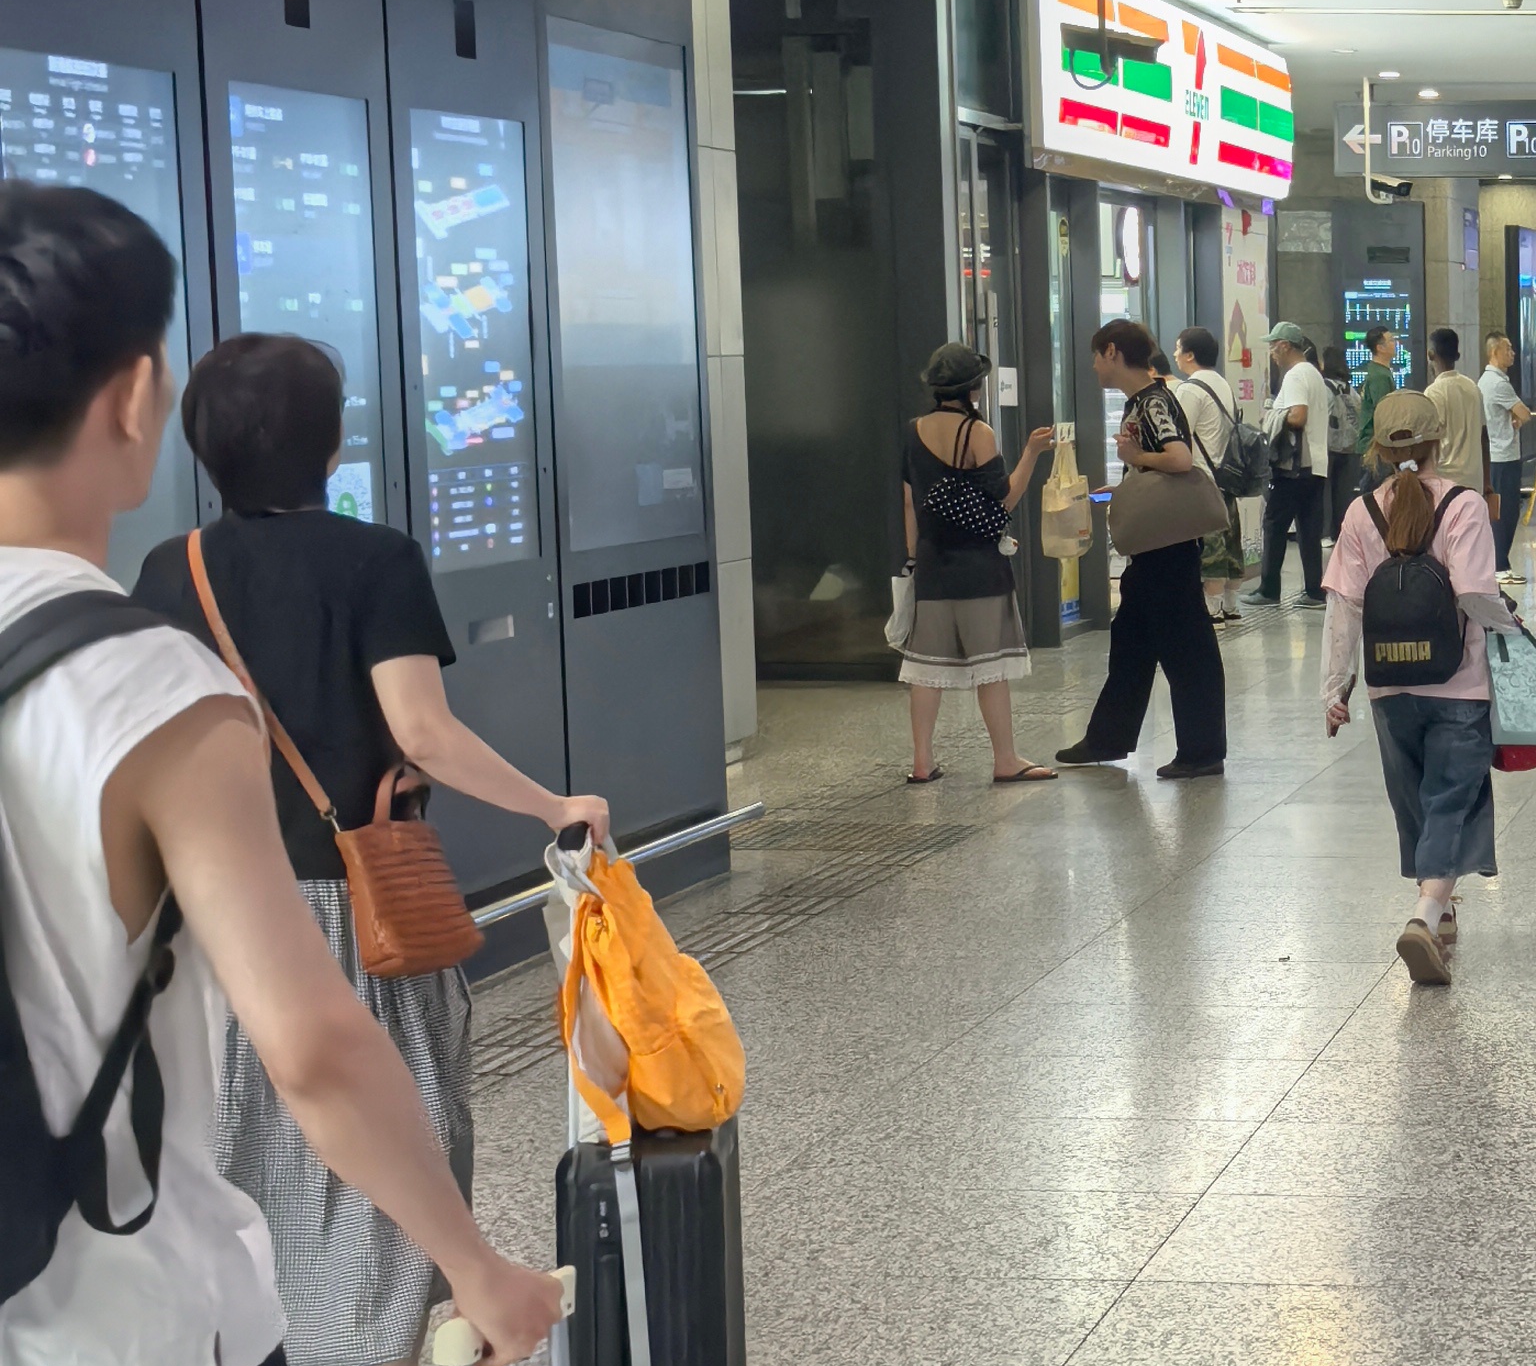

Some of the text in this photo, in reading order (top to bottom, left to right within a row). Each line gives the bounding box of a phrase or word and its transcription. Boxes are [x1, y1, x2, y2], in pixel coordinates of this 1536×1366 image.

[1426, 118, 1499, 143] 停车库
[1426, 144, 1488, 160] Parking10
[1375, 641, 1431, 662] PUMA
